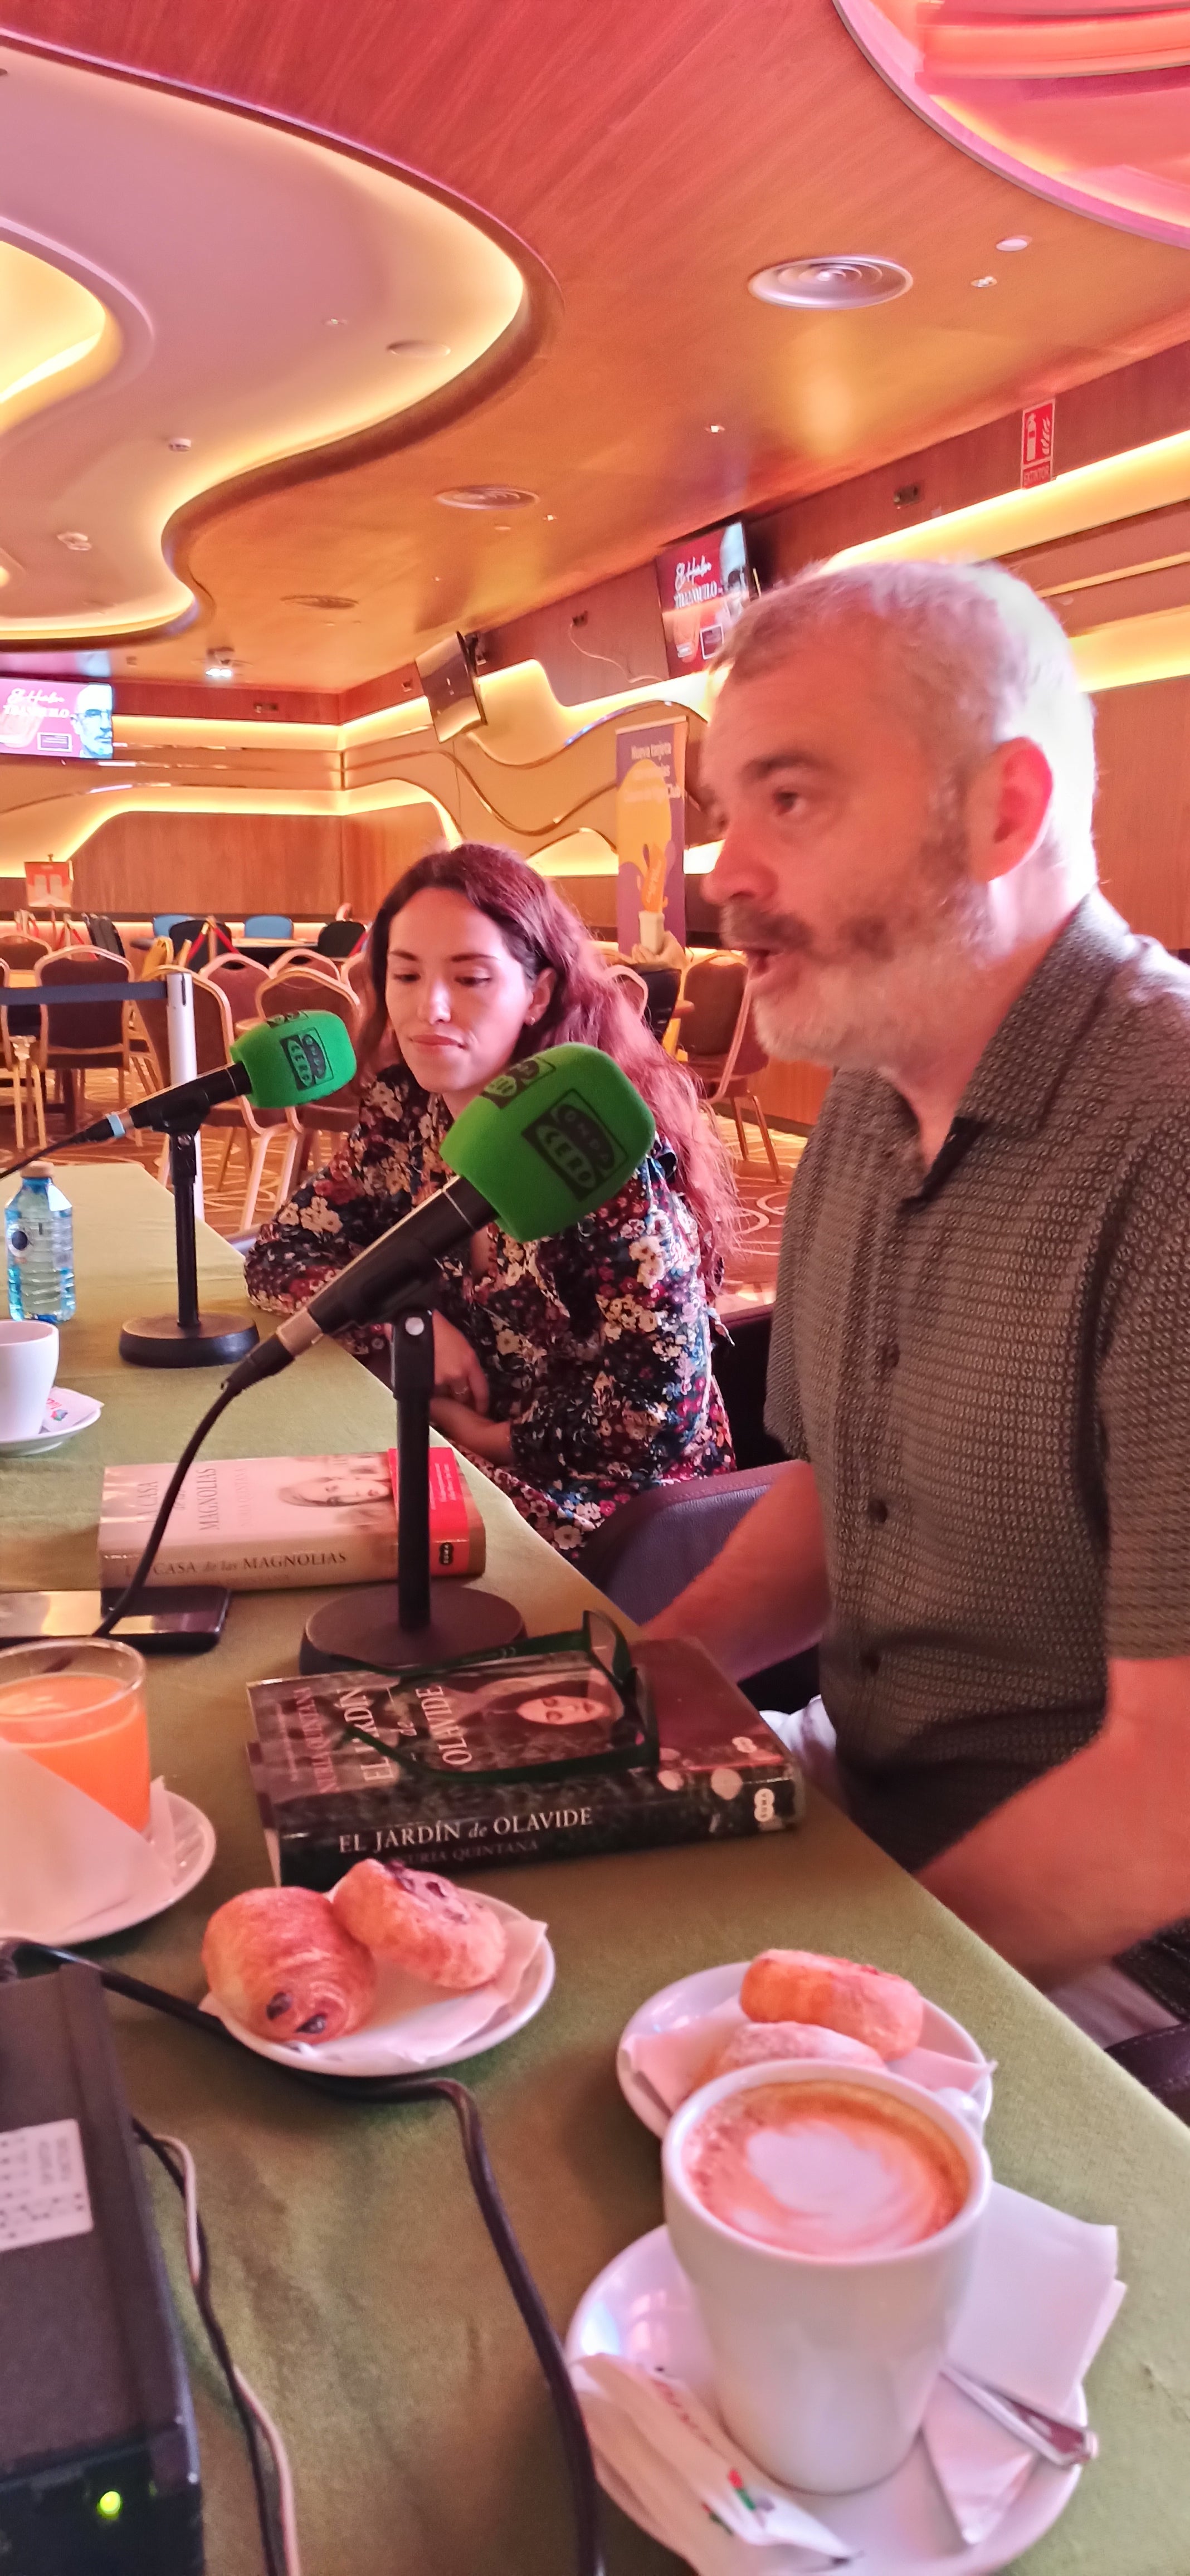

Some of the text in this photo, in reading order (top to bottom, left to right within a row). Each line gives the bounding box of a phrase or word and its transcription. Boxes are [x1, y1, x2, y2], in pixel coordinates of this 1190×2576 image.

[545, 1130, 591, 1183] CERO
[137, 1481, 159, 1507] CASA
[196, 1468, 220, 1530] MAGNOLIAS
[153, 1562, 197, 1575] CASA
[243, 1552, 347, 1570] MAGNOLIAS
[415, 1685, 473, 1765] OLAVIDE
[360, 1755, 394, 1781] EL
[339, 1806, 593, 1854] EL JARDÍN de OLAVIDE
